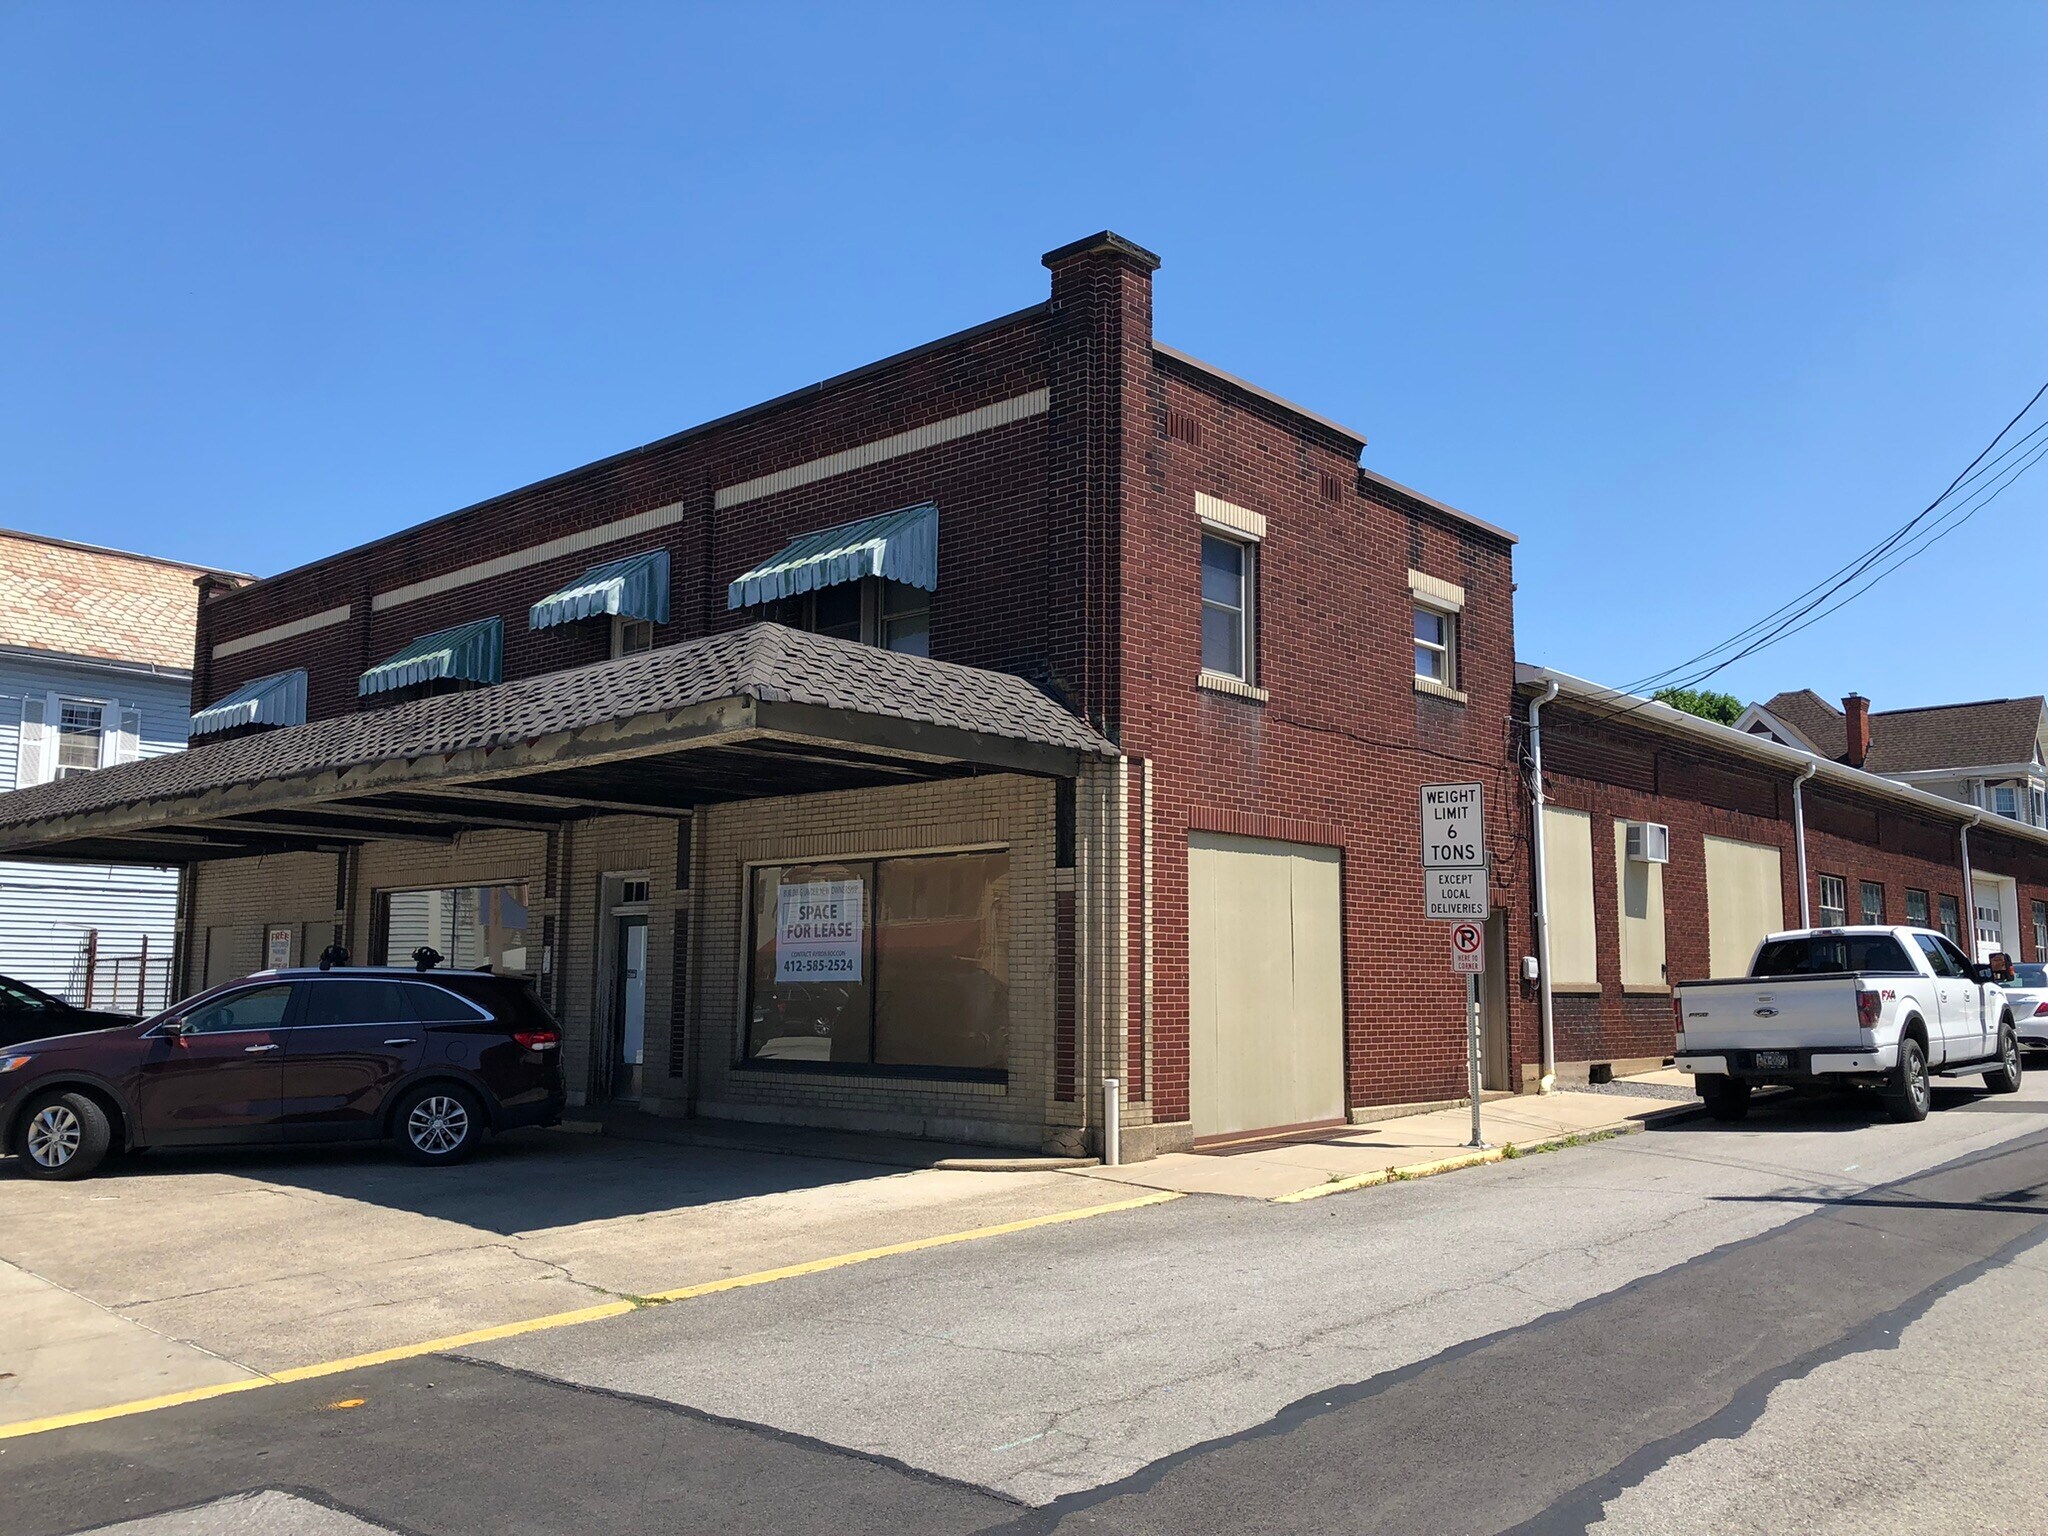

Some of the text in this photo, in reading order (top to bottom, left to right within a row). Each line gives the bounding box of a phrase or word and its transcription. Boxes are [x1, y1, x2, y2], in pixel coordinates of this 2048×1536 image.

[1426, 789, 1476, 804] WEIGHT
[1434, 806, 1469, 820] LIMIT
[1447, 824, 1458, 839] 6
[1431, 844, 1475, 861] TONS
[1438, 874, 1473, 885] EXCEPT
[1441, 889, 1471, 900] LOCAL
[799, 904, 837, 920] SPACE
[1431, 903, 1483, 914] DELIVERIES
[271, 931, 289, 941] FREE
[787, 922, 852, 939] FOR LEASE
[1457, 954, 1479, 962] HERE TO
[784, 959, 853, 972] 412-585-2524
[1458, 962, 1479, 970] CORNER
[1881, 989, 1897, 1001] FX4
